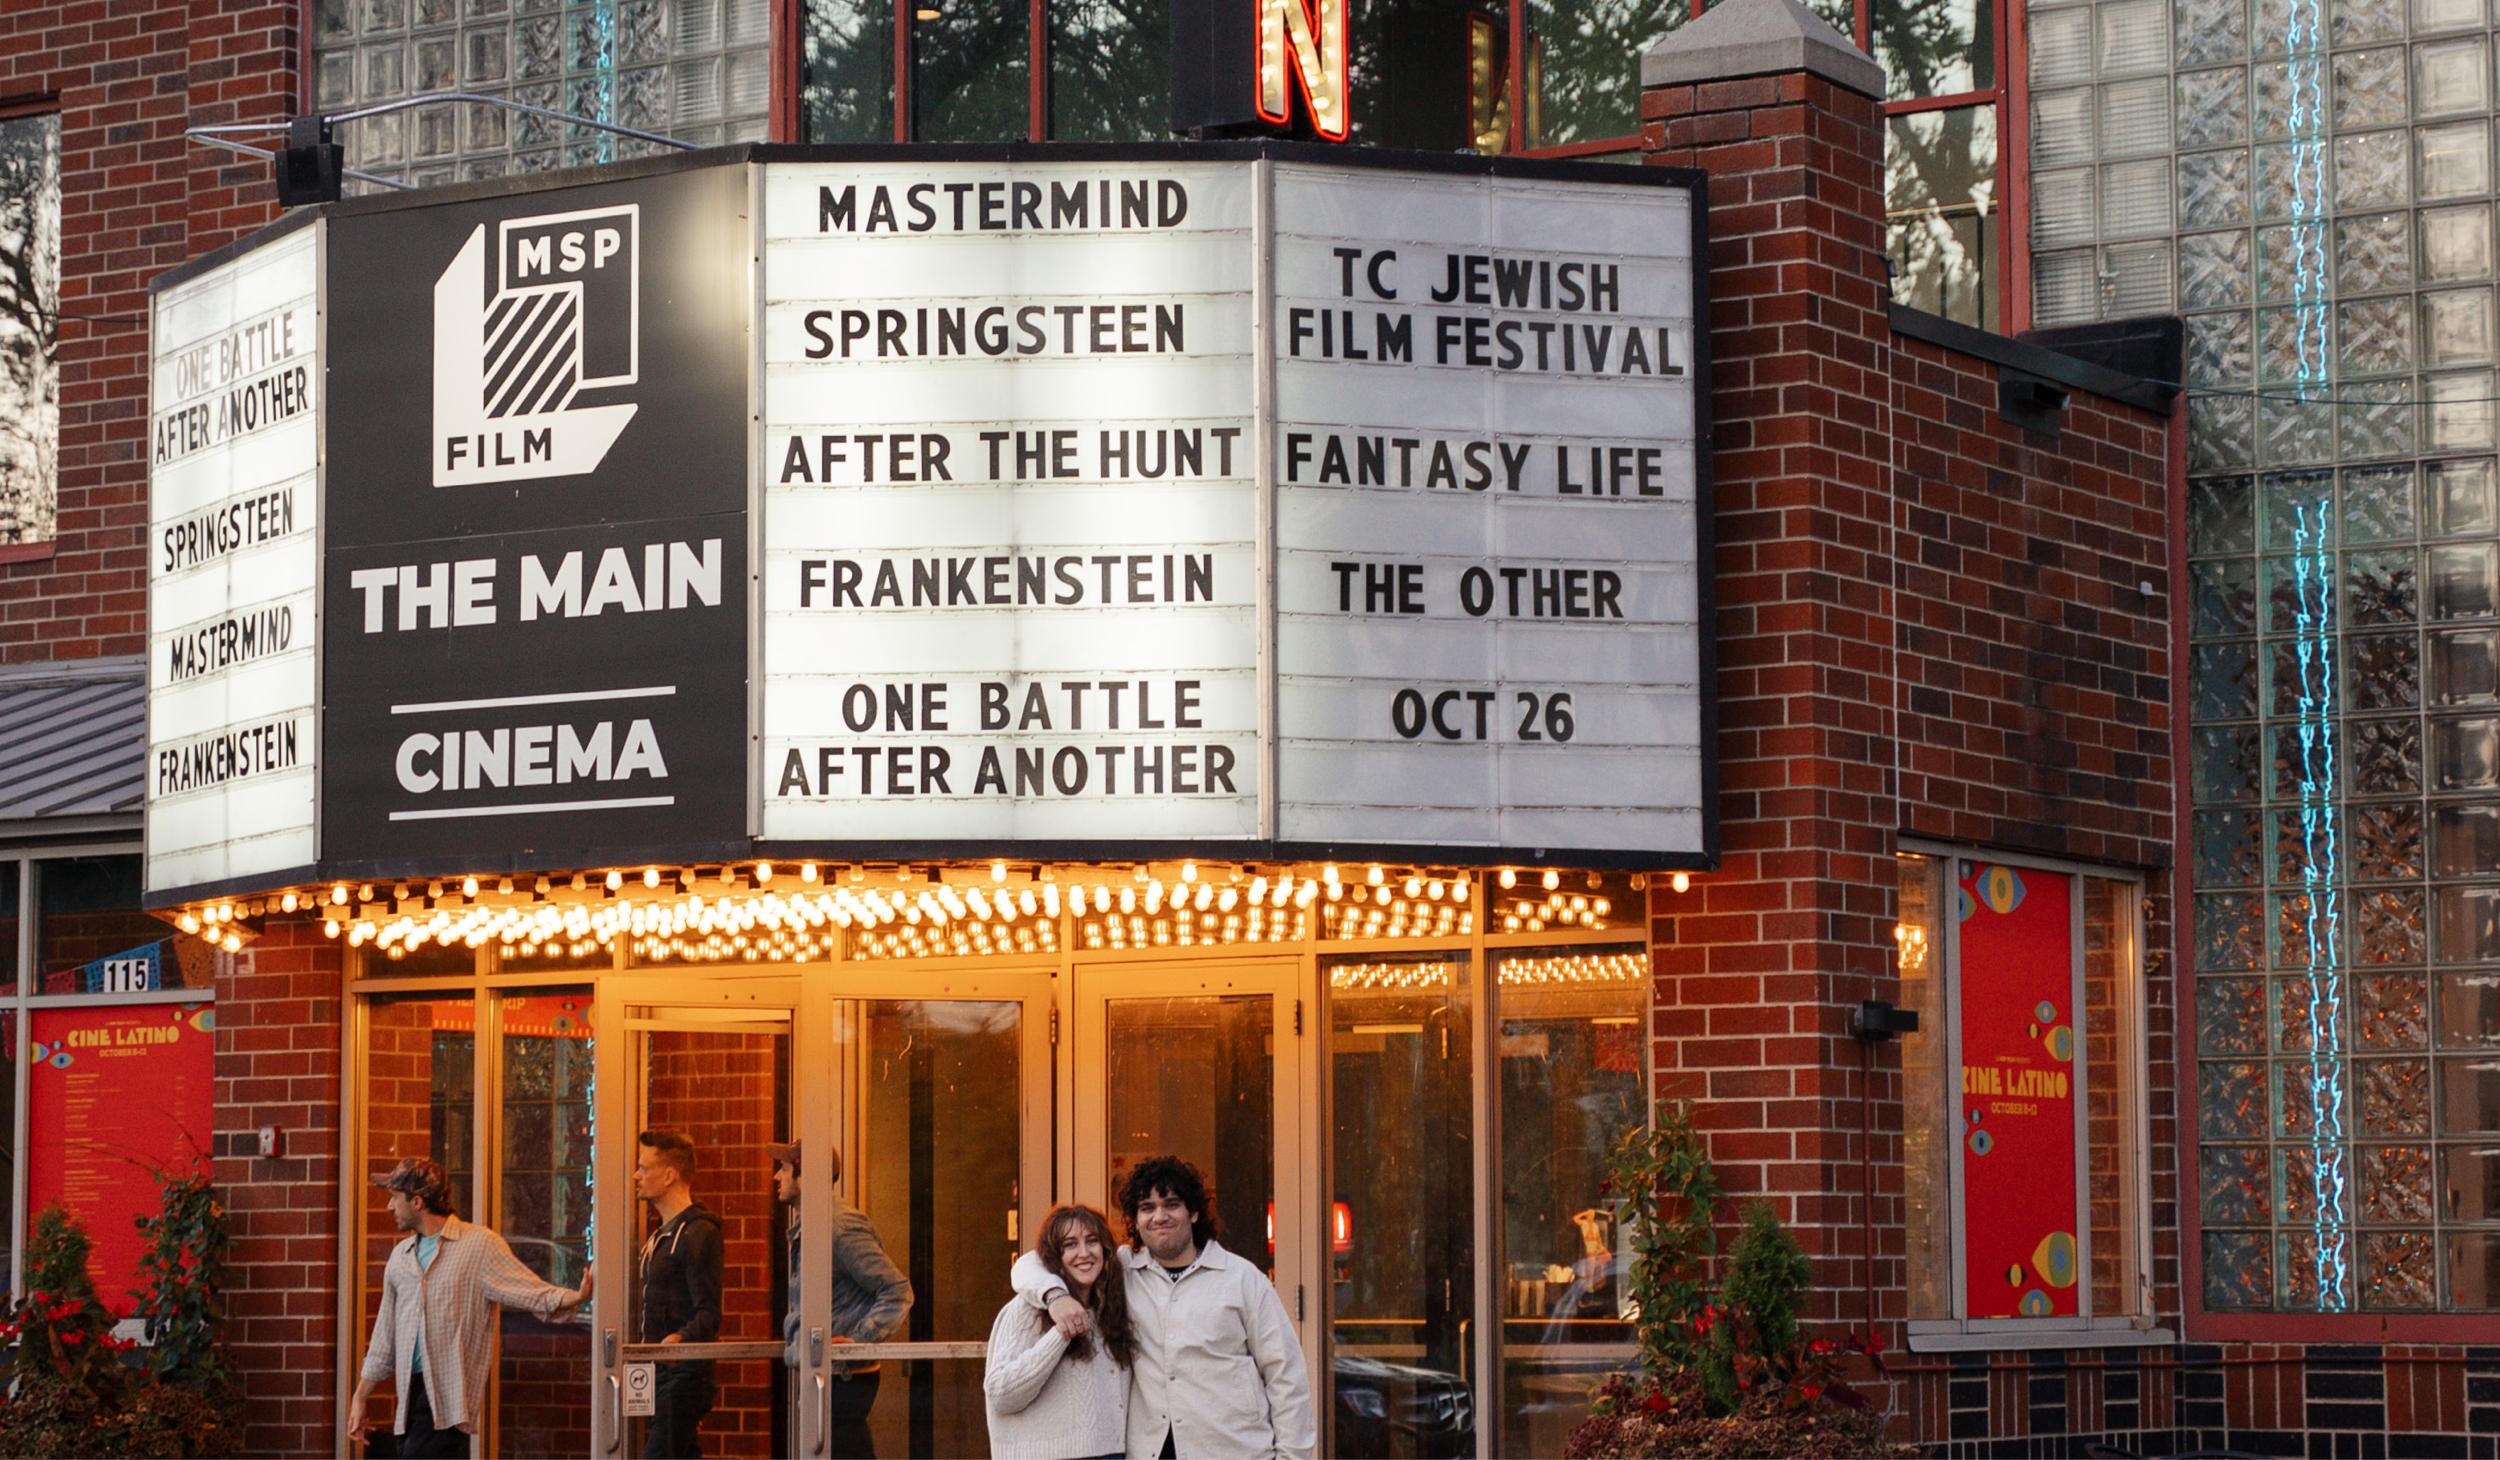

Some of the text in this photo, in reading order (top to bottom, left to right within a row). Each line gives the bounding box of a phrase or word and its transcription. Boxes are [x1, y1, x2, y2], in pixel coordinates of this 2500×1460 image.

[1255, 0, 1349, 142] N
[820, 180, 1187, 232] MASTERMIND
[519, 229, 620, 277] MSP
[1334, 248, 1618, 312] TC JEWISH
[175, 312, 294, 397] ONE BATTLE
[804, 304, 1183, 359] SPRINGSTEEN
[1290, 308, 1683, 375] FILM FESTIVAL
[156, 366, 308, 464] AFTER ANOTHER
[448, 428, 551, 470] FILM
[781, 427, 1241, 483] AFTER THE HUNT
[1288, 433, 1663, 496] FANTASY LIFE
[165, 488, 292, 572] SPRINGSTEEN
[351, 539, 721, 633] THE MAIN
[801, 554, 1212, 607] FRANKENSTEIN
[1331, 562, 1623, 617] THE OTHER
[171, 607, 291, 681] MASTERMIND
[842, 680, 1202, 732] ONE BATTLE
[1392, 688, 1573, 742] OCT 26
[160, 720, 296, 795] FRANKENSTEIN
[396, 719, 668, 793] CINEMA
[778, 745, 1237, 796] AFTER ANOTHER
[108, 960, 146, 991] 115
[67, 1025, 180, 1047] CINE LATINO
[2007, 1069, 2068, 1098] LATINO
